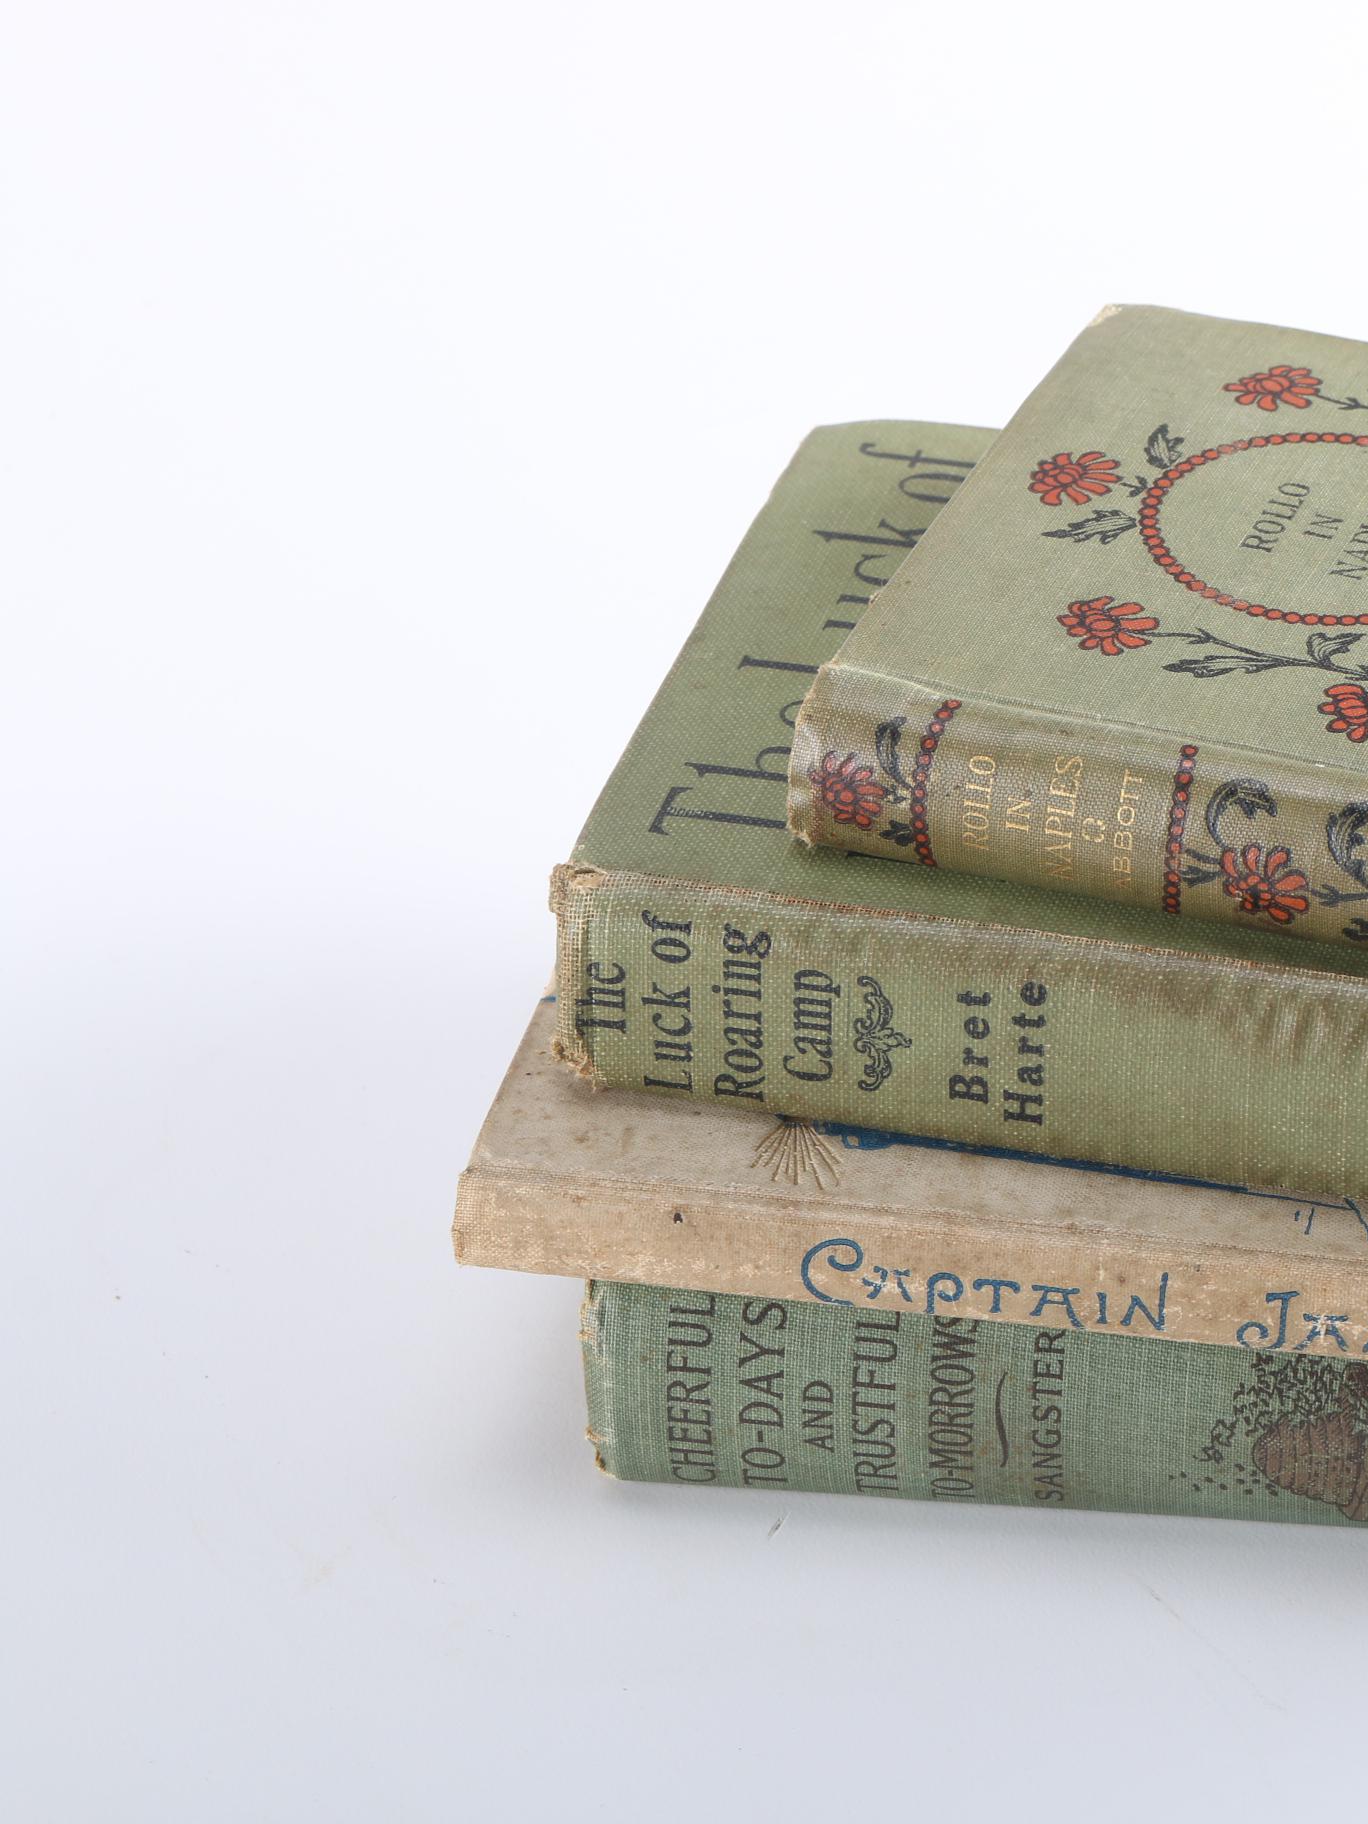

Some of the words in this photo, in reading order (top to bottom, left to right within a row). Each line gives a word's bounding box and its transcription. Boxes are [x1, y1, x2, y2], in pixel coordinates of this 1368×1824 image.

[1239, 482, 1311, 553] ROLLO
[1302, 512, 1344, 541] IN
[962, 754, 997, 851] ROLLO
[1005, 797, 1032, 833] IN
[1044, 755, 1083, 881] NAPLES
[1112, 769, 1144, 890] ABBOTT
[641, 909, 693, 964] of
[575, 961, 627, 1035] The
[641, 981, 694, 1094] Luck
[713, 922, 773, 1103] Roaring
[782, 968, 842, 1083] Camp
[948, 990, 992, 1105] Bret
[1003, 980, 1049, 1127] Harte
[800, 1237, 1170, 1332] CAPTAIN
[666, 1294, 717, 1486] CHEERFUL
[738, 1299, 789, 1486] TO-DAYS
[800, 1379, 836, 1453] AND
[851, 1311, 901, 1494] TRUSTFUL
[1031, 1329, 1067, 1501] SANGSTER
